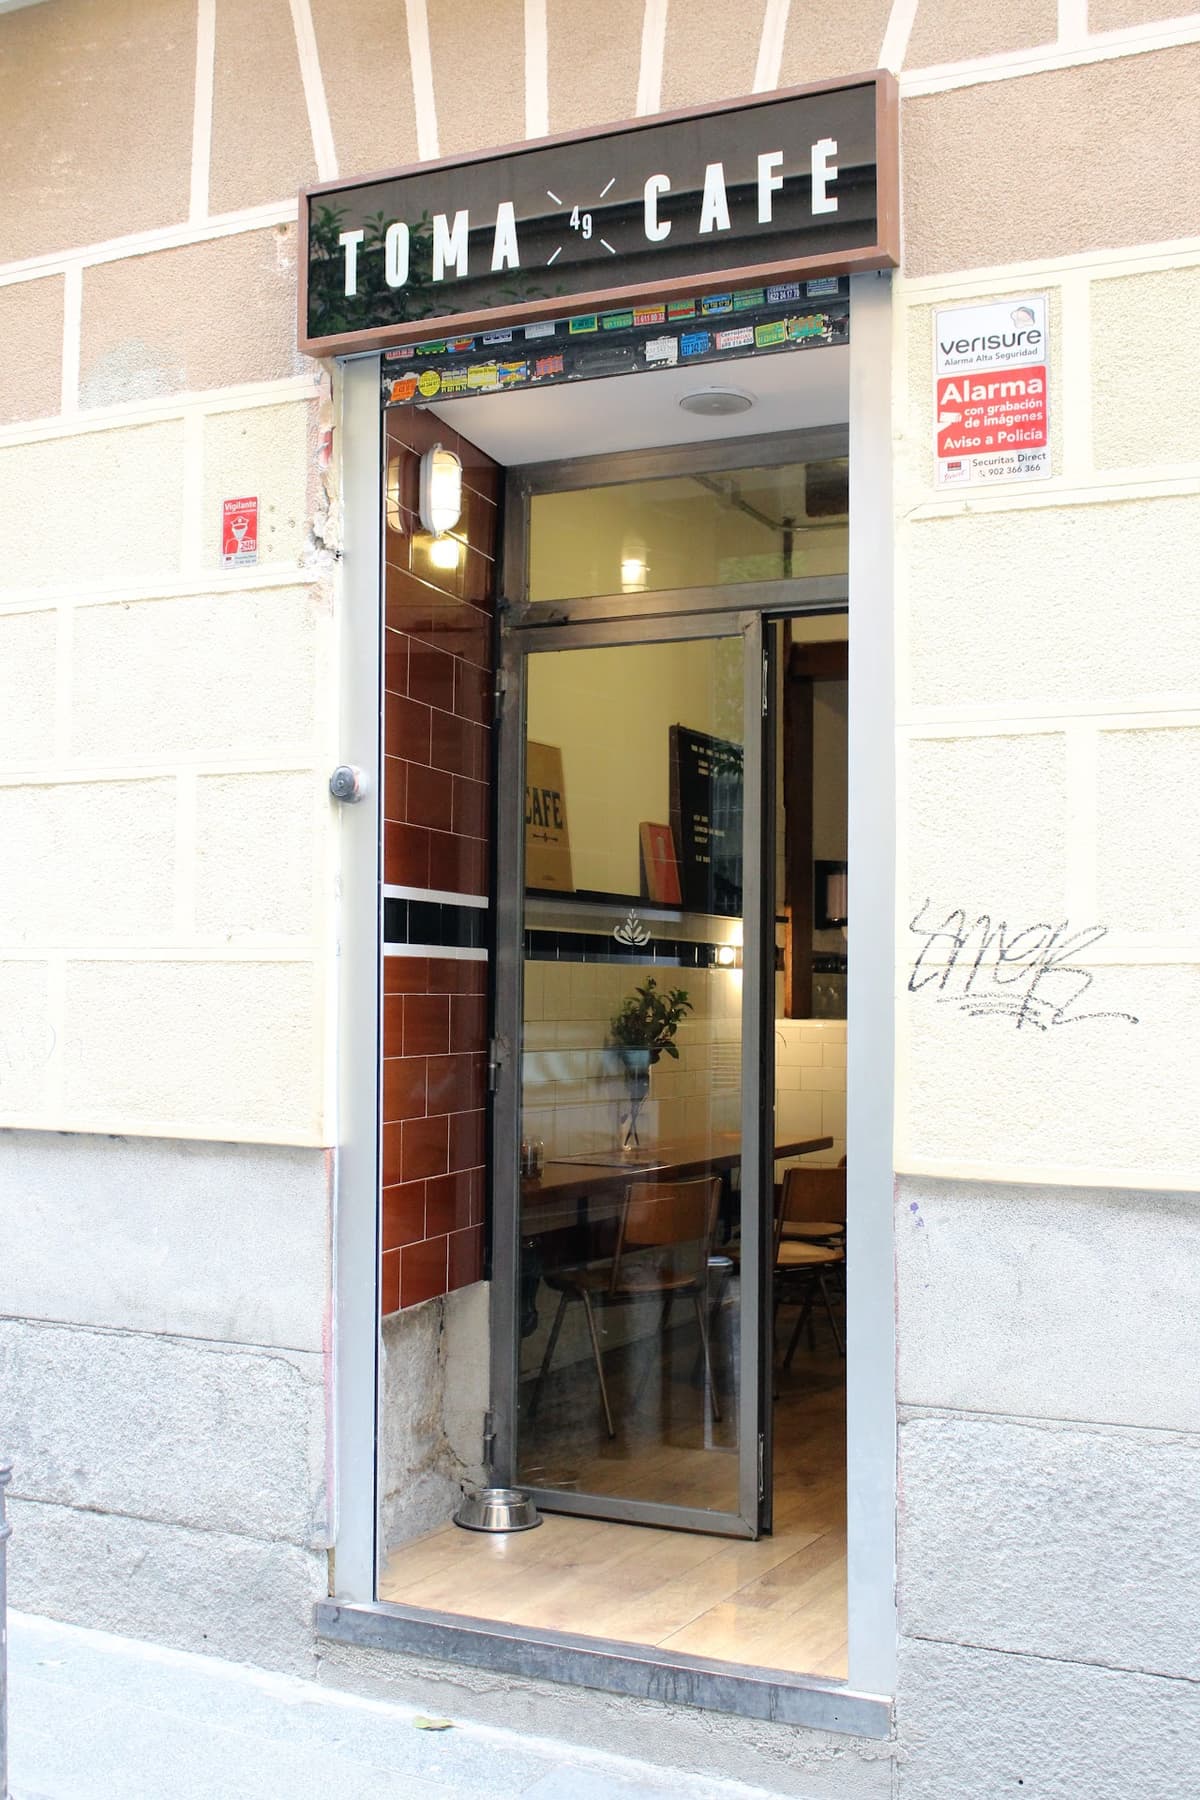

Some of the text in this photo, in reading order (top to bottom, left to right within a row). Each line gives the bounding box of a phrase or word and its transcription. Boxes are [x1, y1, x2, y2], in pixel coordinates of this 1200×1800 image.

[339, 138, 838, 296] TOMA 49 CAFÉ
[940, 329, 1042, 355] verisure
[944, 347, 1038, 367] Alarma Alta Seguridad
[940, 378, 1043, 406] Alarma
[964, 399, 1042, 416] con grabación
[964, 411, 1043, 429] de imágenes
[943, 429, 1043, 450] Aviso a Policía
[972, 452, 1047, 467] Securitas Direct
[988, 463, 1041, 476] 902 366 366
[225, 501, 257, 512] Vigilante
